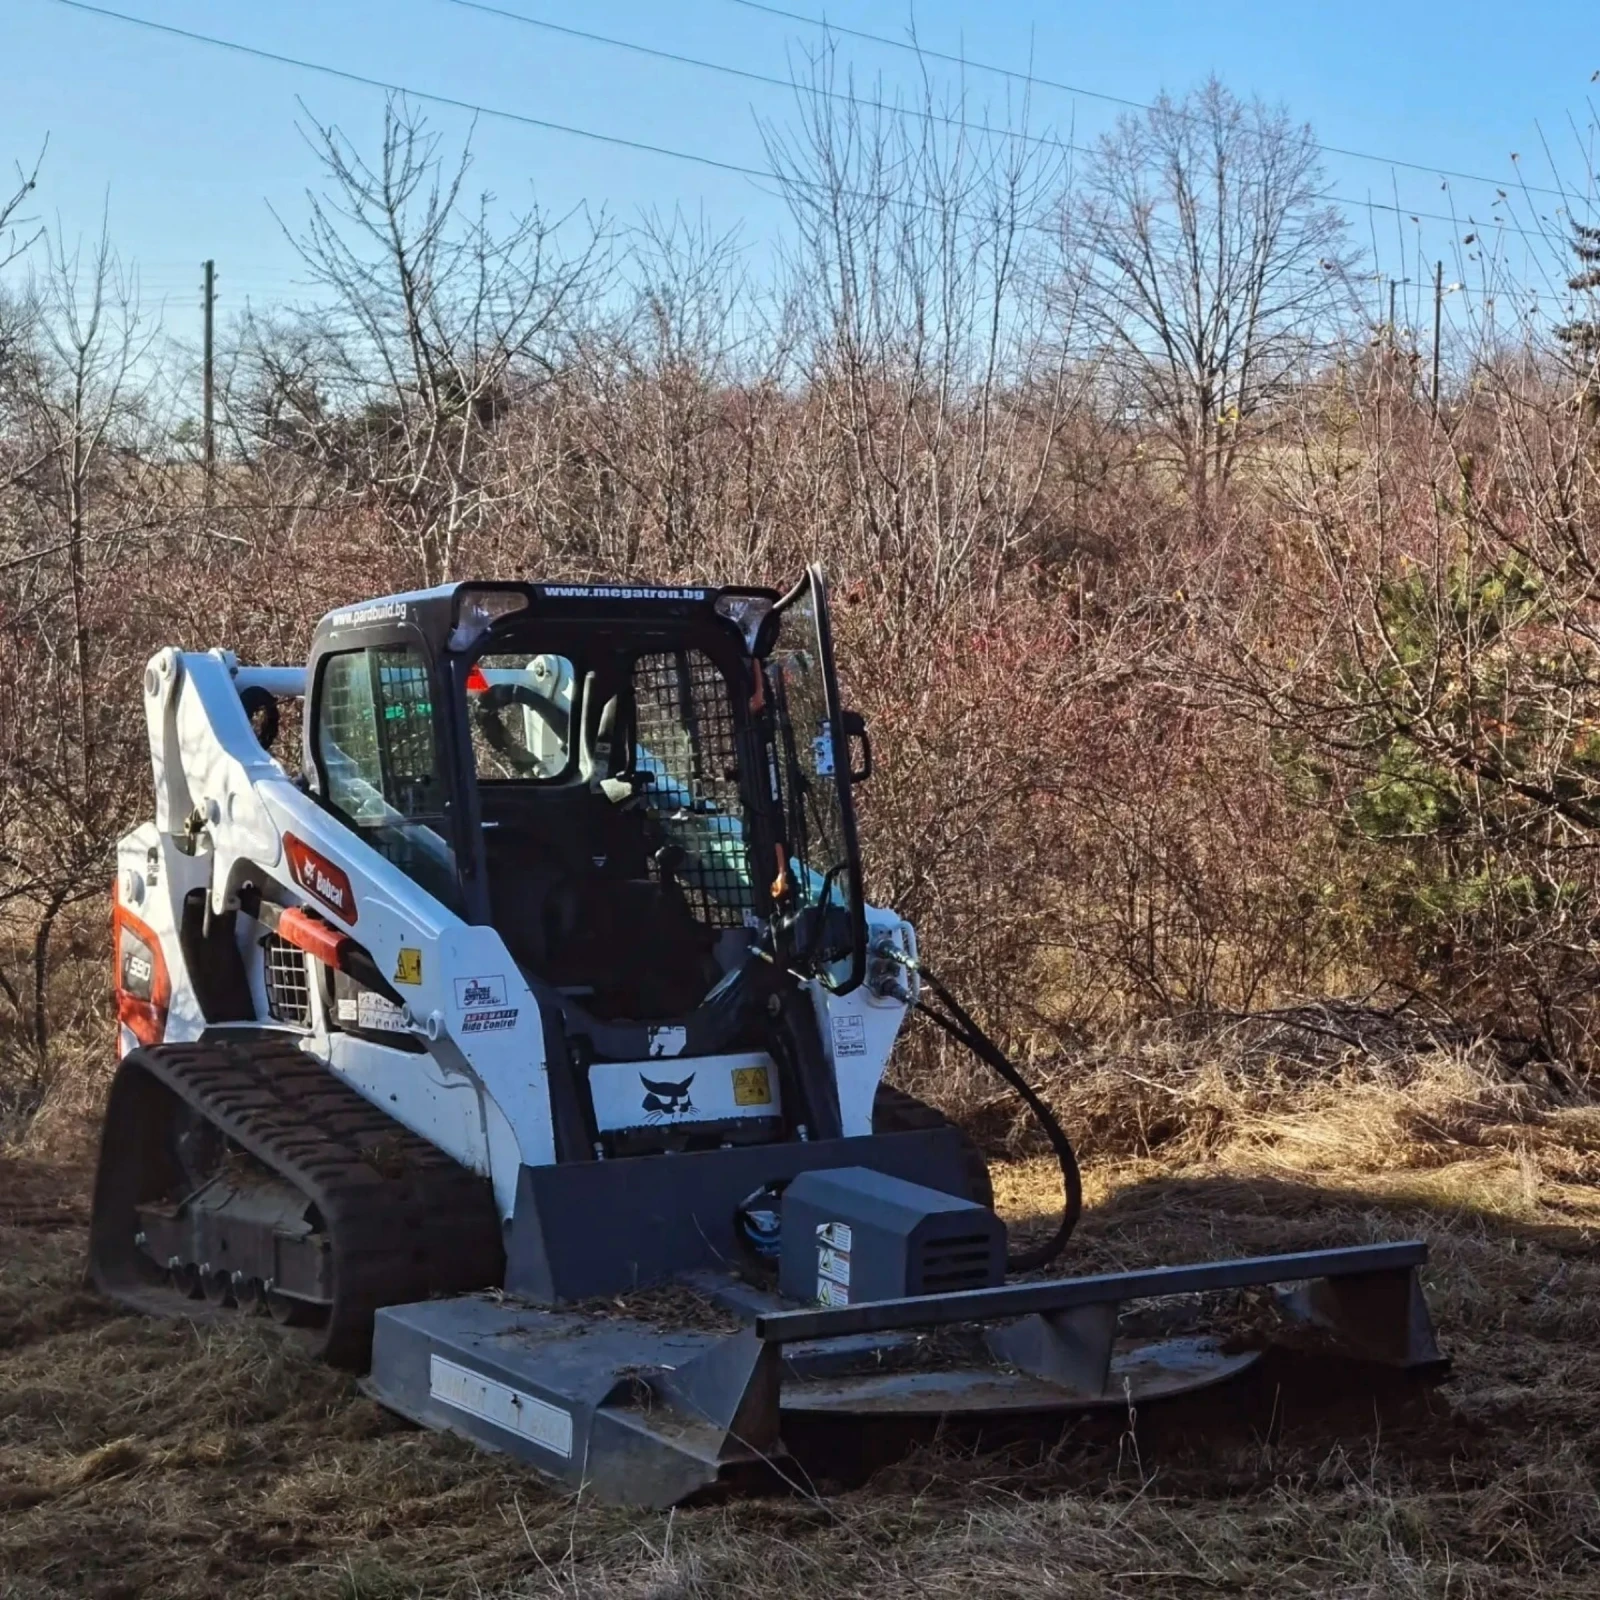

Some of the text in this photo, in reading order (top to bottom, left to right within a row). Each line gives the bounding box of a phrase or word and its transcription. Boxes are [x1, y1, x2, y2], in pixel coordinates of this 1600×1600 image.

[543, 587, 705, 600] www.megatron.bg
[315, 870, 343, 908] Bobcat
[483, 1018, 517, 1030] Control
